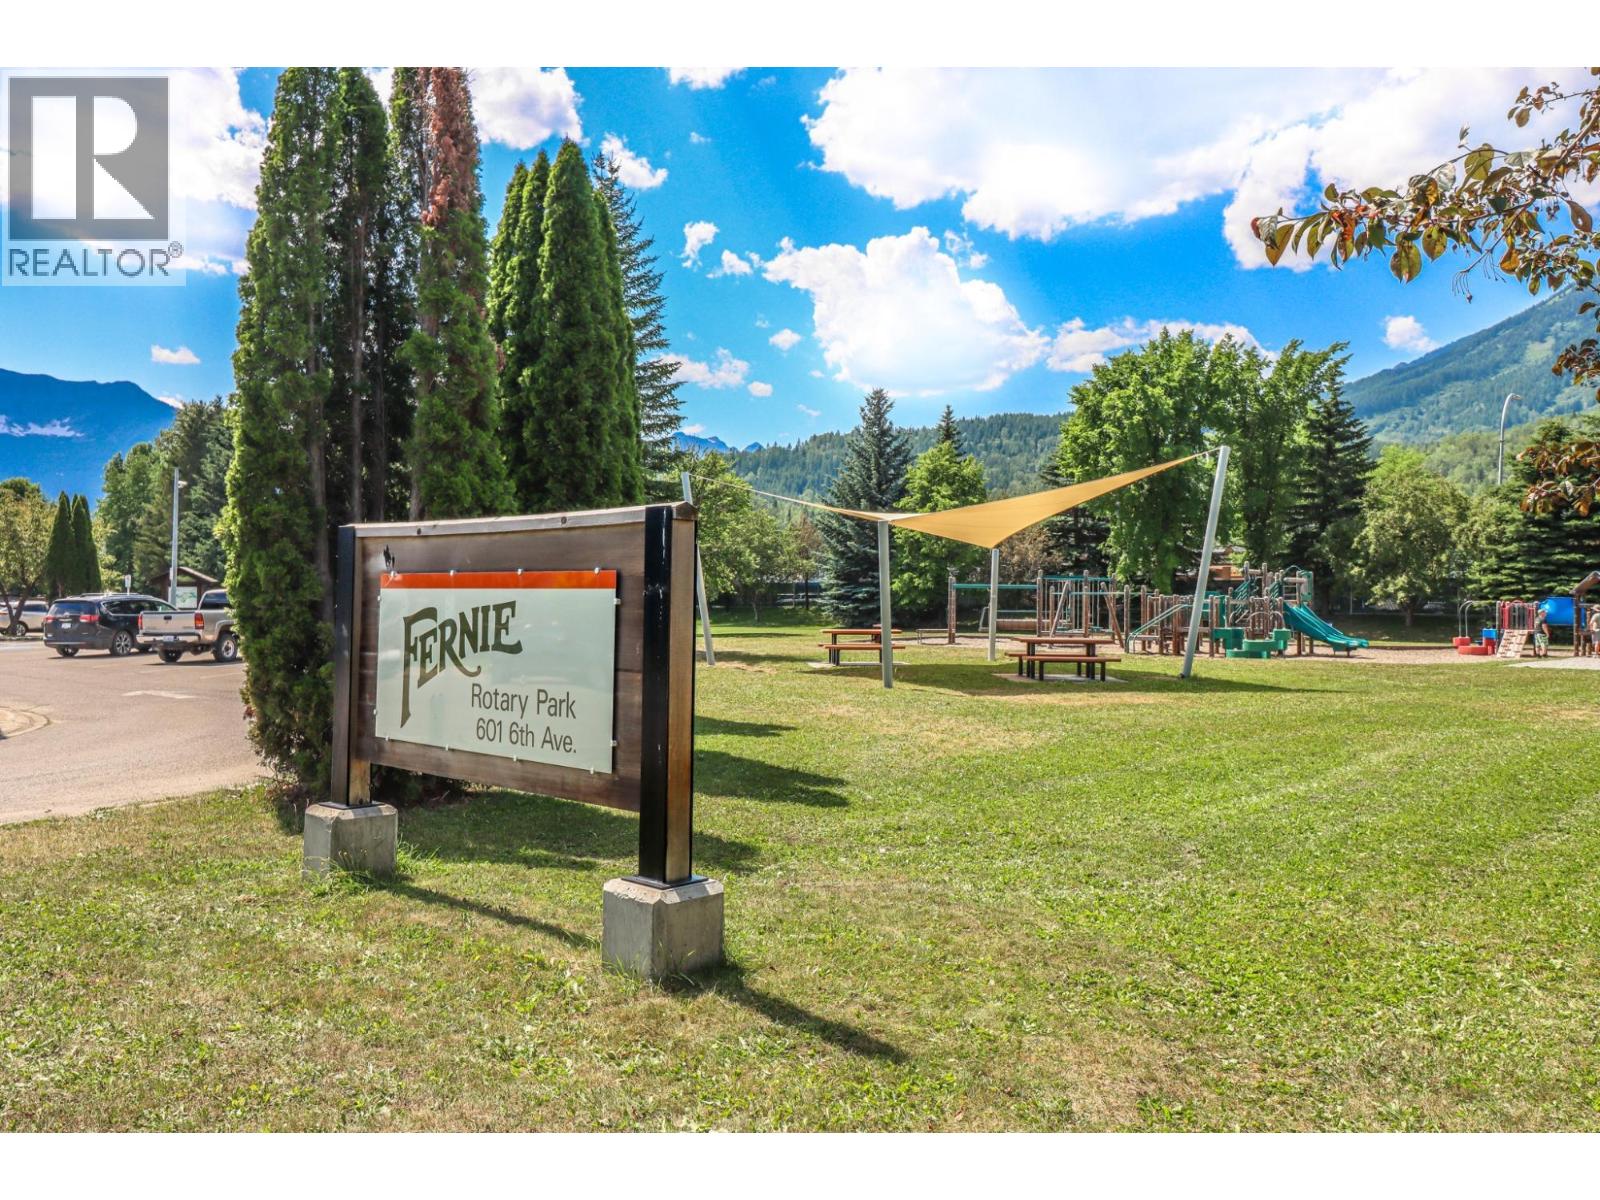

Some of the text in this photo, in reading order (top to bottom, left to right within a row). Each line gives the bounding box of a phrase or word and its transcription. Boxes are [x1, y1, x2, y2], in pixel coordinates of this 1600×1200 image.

[400, 600, 523, 729] FERNIE
[471, 683, 577, 719] Rotary Park
[476, 717, 577, 754] 601 6th Ave.
